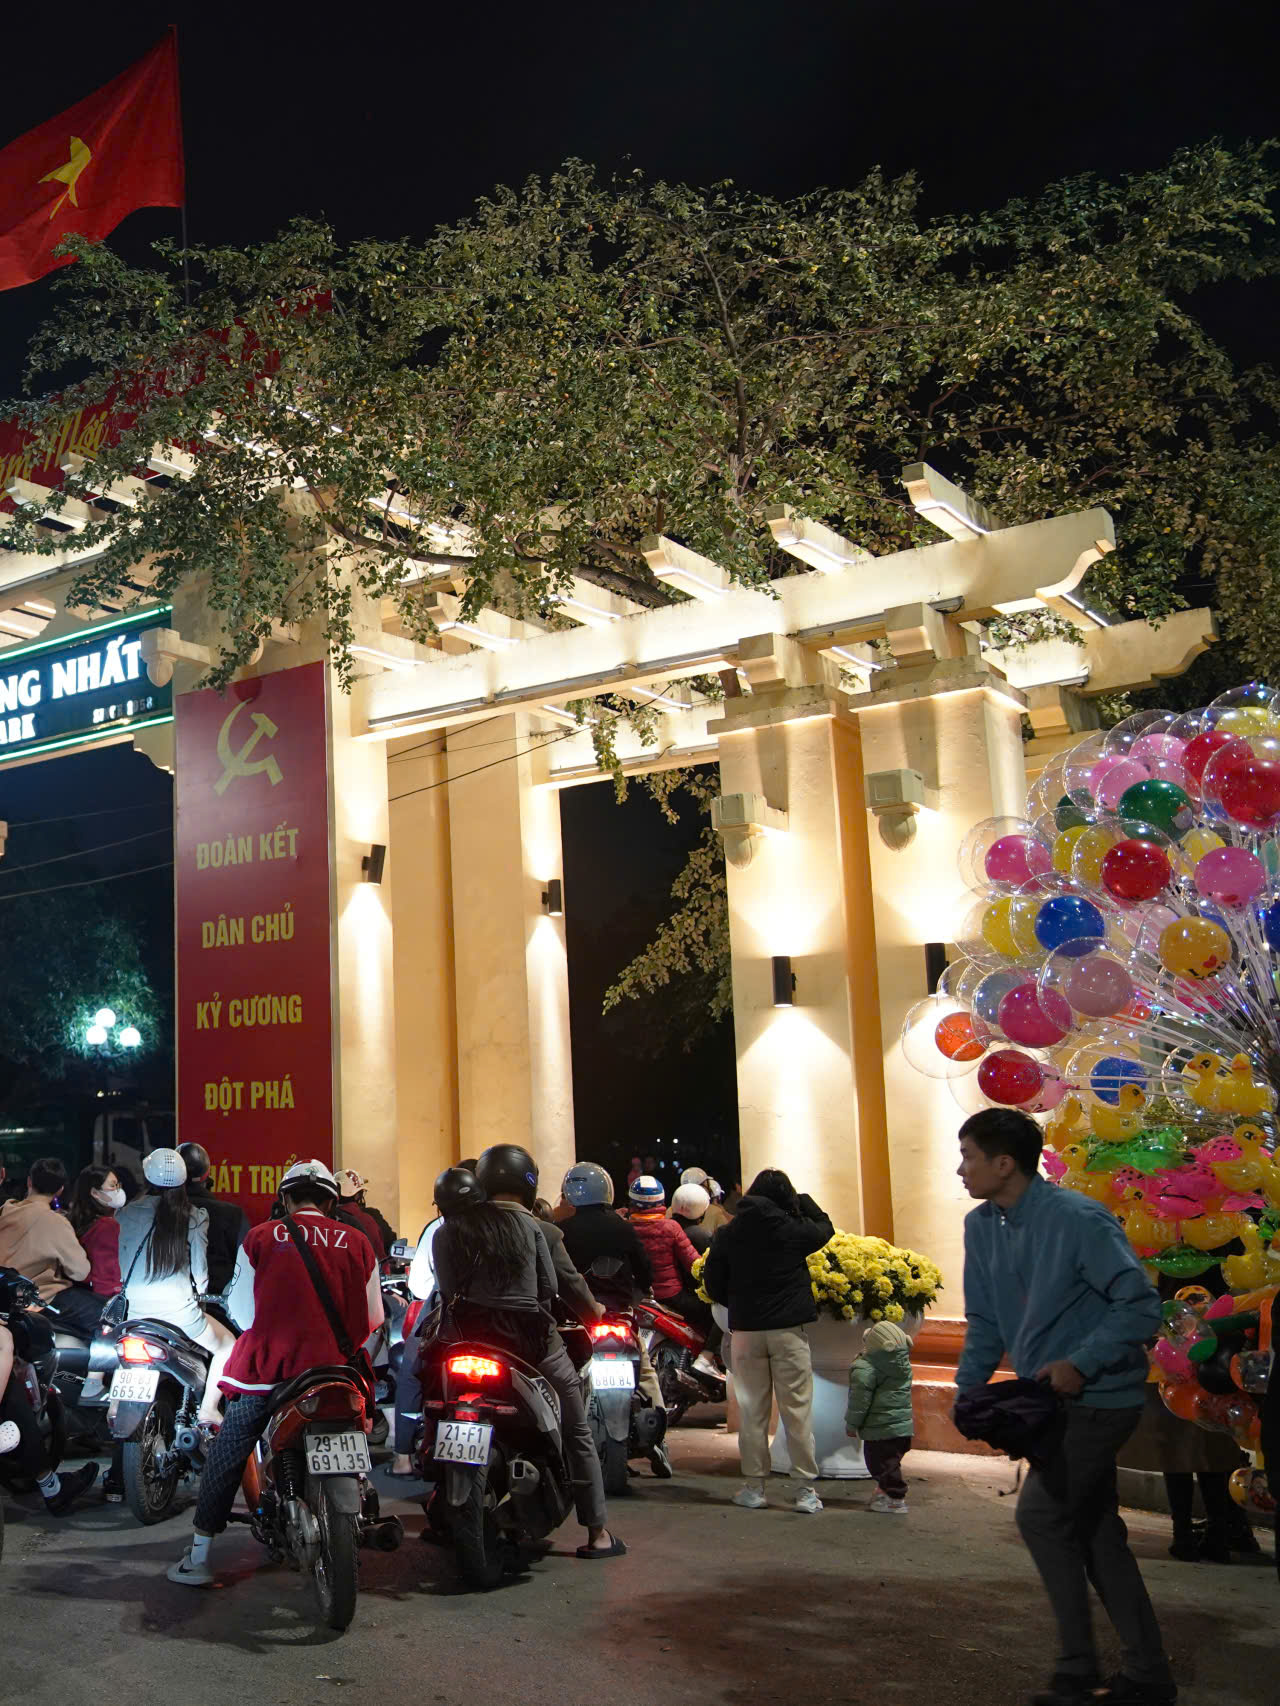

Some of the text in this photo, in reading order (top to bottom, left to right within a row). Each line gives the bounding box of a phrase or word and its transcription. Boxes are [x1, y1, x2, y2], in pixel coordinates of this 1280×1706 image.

[52, 635, 141, 700] NHẤT
[196, 820, 299, 870] ĐOÀN KẾT
[202, 902, 295, 949] DÂN CHỦ
[196, 992, 303, 1030] KỶ CƯƠNG
[205, 1074, 295, 1117] ĐỘT PHÁ
[209, 1159, 242, 1194] HÁT
[111, 1385, 153, 1401] 665.24
[314, 1435, 357, 1453] 29-H1
[437, 1441, 486, 1462] 243.04
[445, 1424, 484, 1444] 21-F1
[311, 1453, 366, 1471] 691.35
